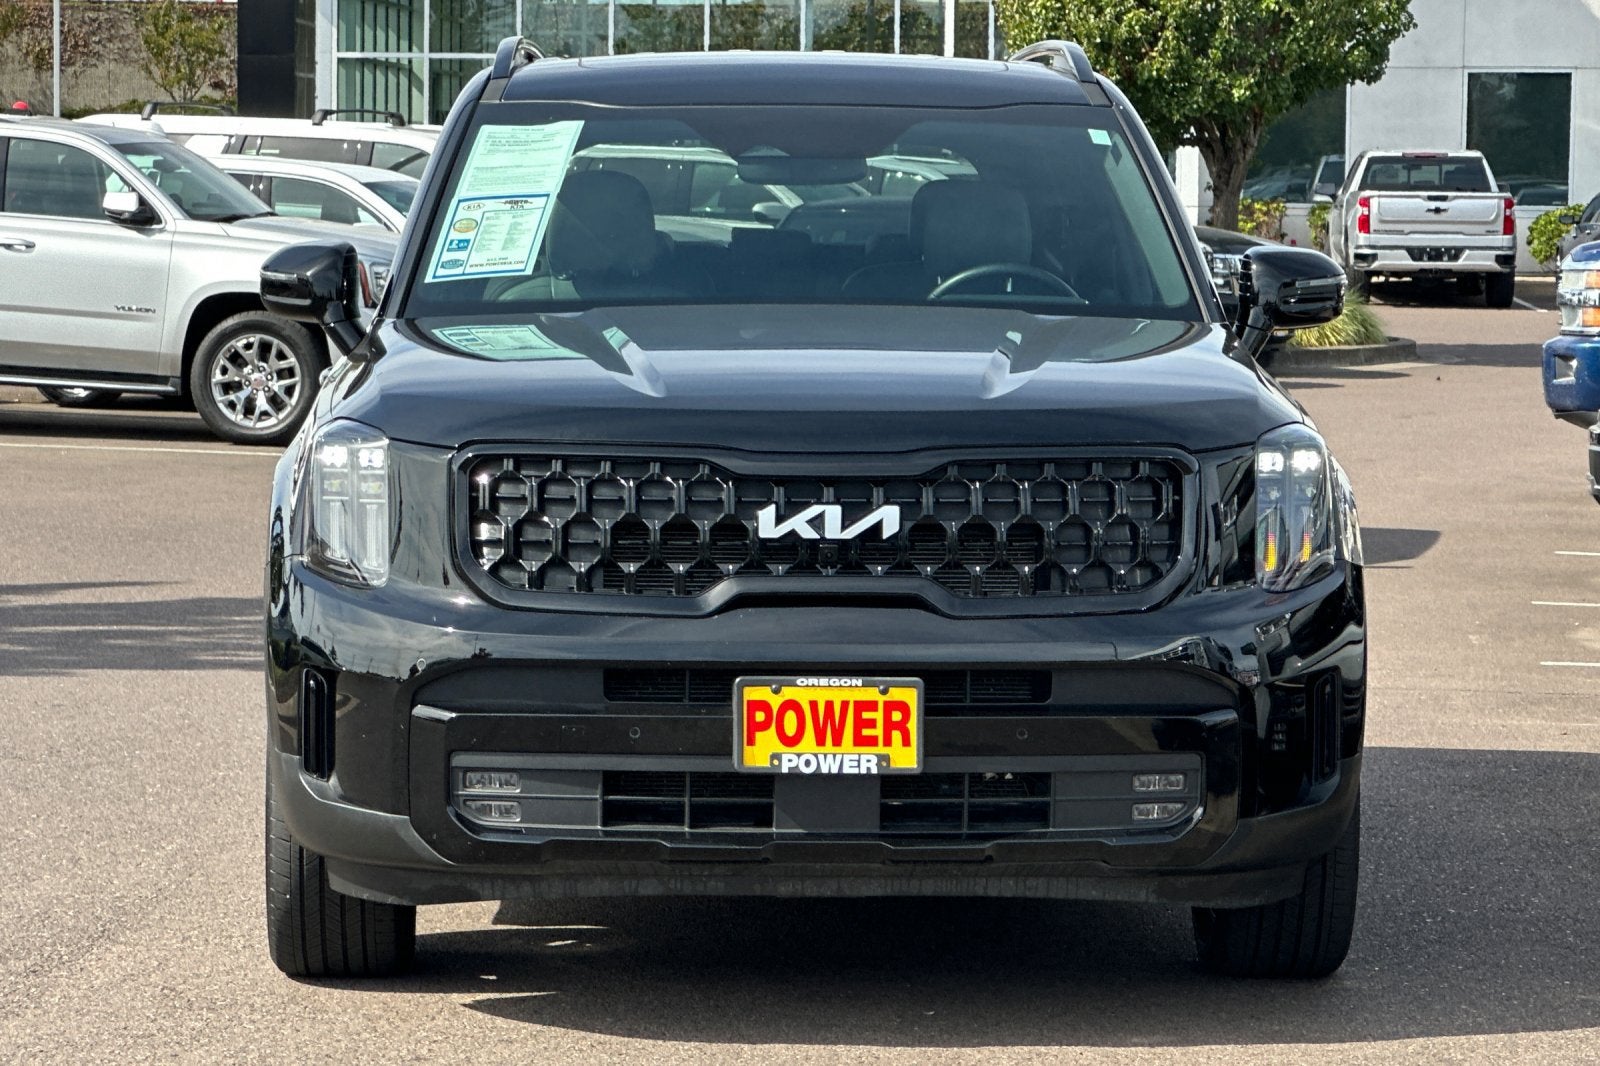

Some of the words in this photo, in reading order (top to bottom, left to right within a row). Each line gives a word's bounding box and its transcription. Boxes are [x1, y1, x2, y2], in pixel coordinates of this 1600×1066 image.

[757, 503, 900, 540] KIA
[796, 678, 863, 687] OREGON
[746, 699, 912, 748] POWER
[781, 753, 878, 775] POWER
